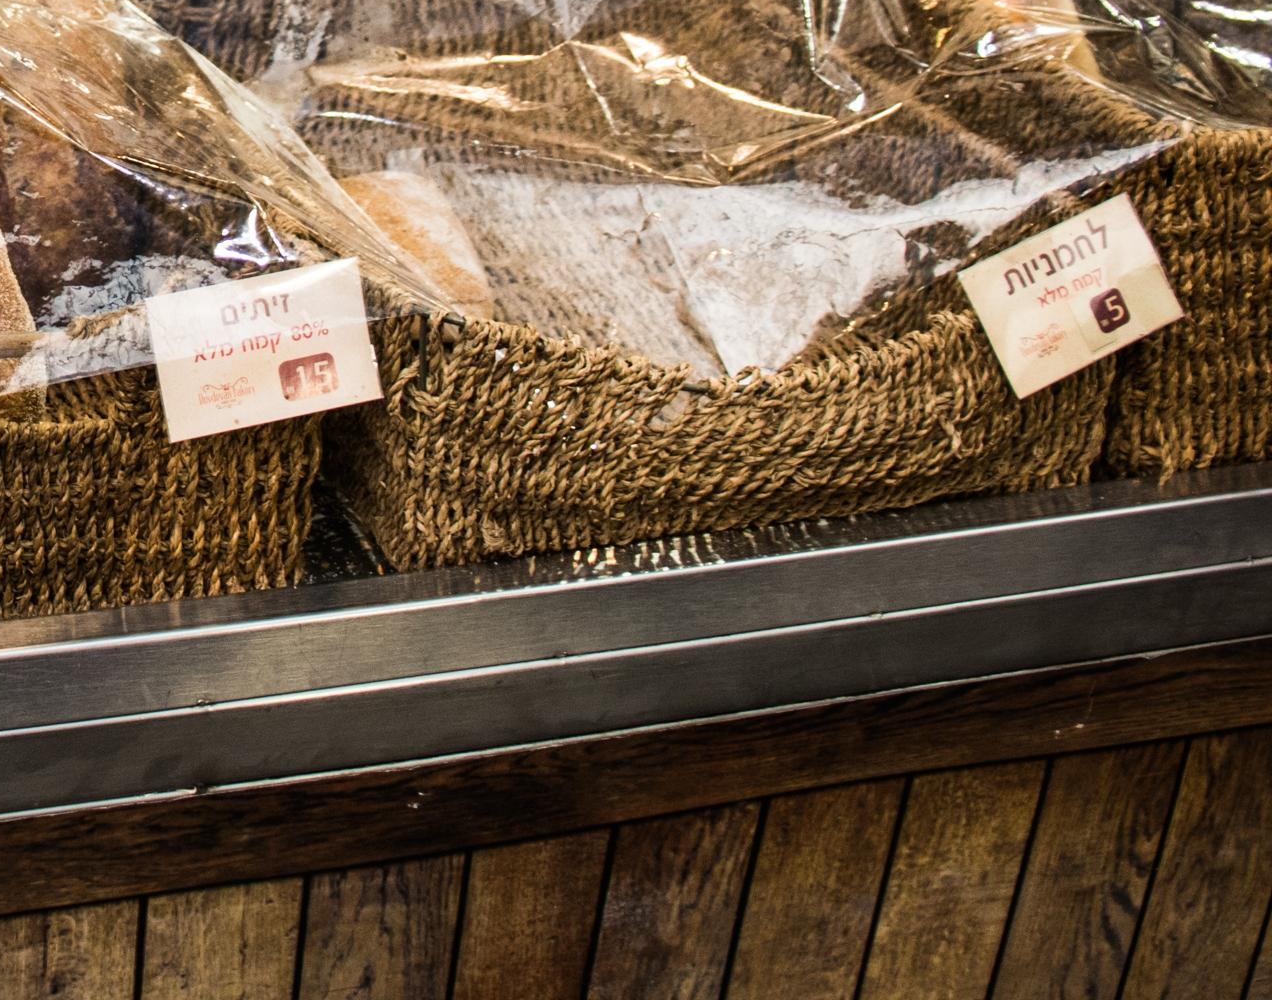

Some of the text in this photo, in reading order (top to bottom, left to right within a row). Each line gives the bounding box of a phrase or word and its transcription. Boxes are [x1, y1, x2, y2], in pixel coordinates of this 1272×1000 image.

[1003, 218, 1109, 296] לחמניות
[1036, 267, 1103, 308] קמח מלא
[221, 293, 290, 326] זיתים
[1106, 295, 1125, 321] 5
[194, 338, 233, 363] מלא
[241, 331, 281, 354] קמח
[296, 360, 333, 390] 15
